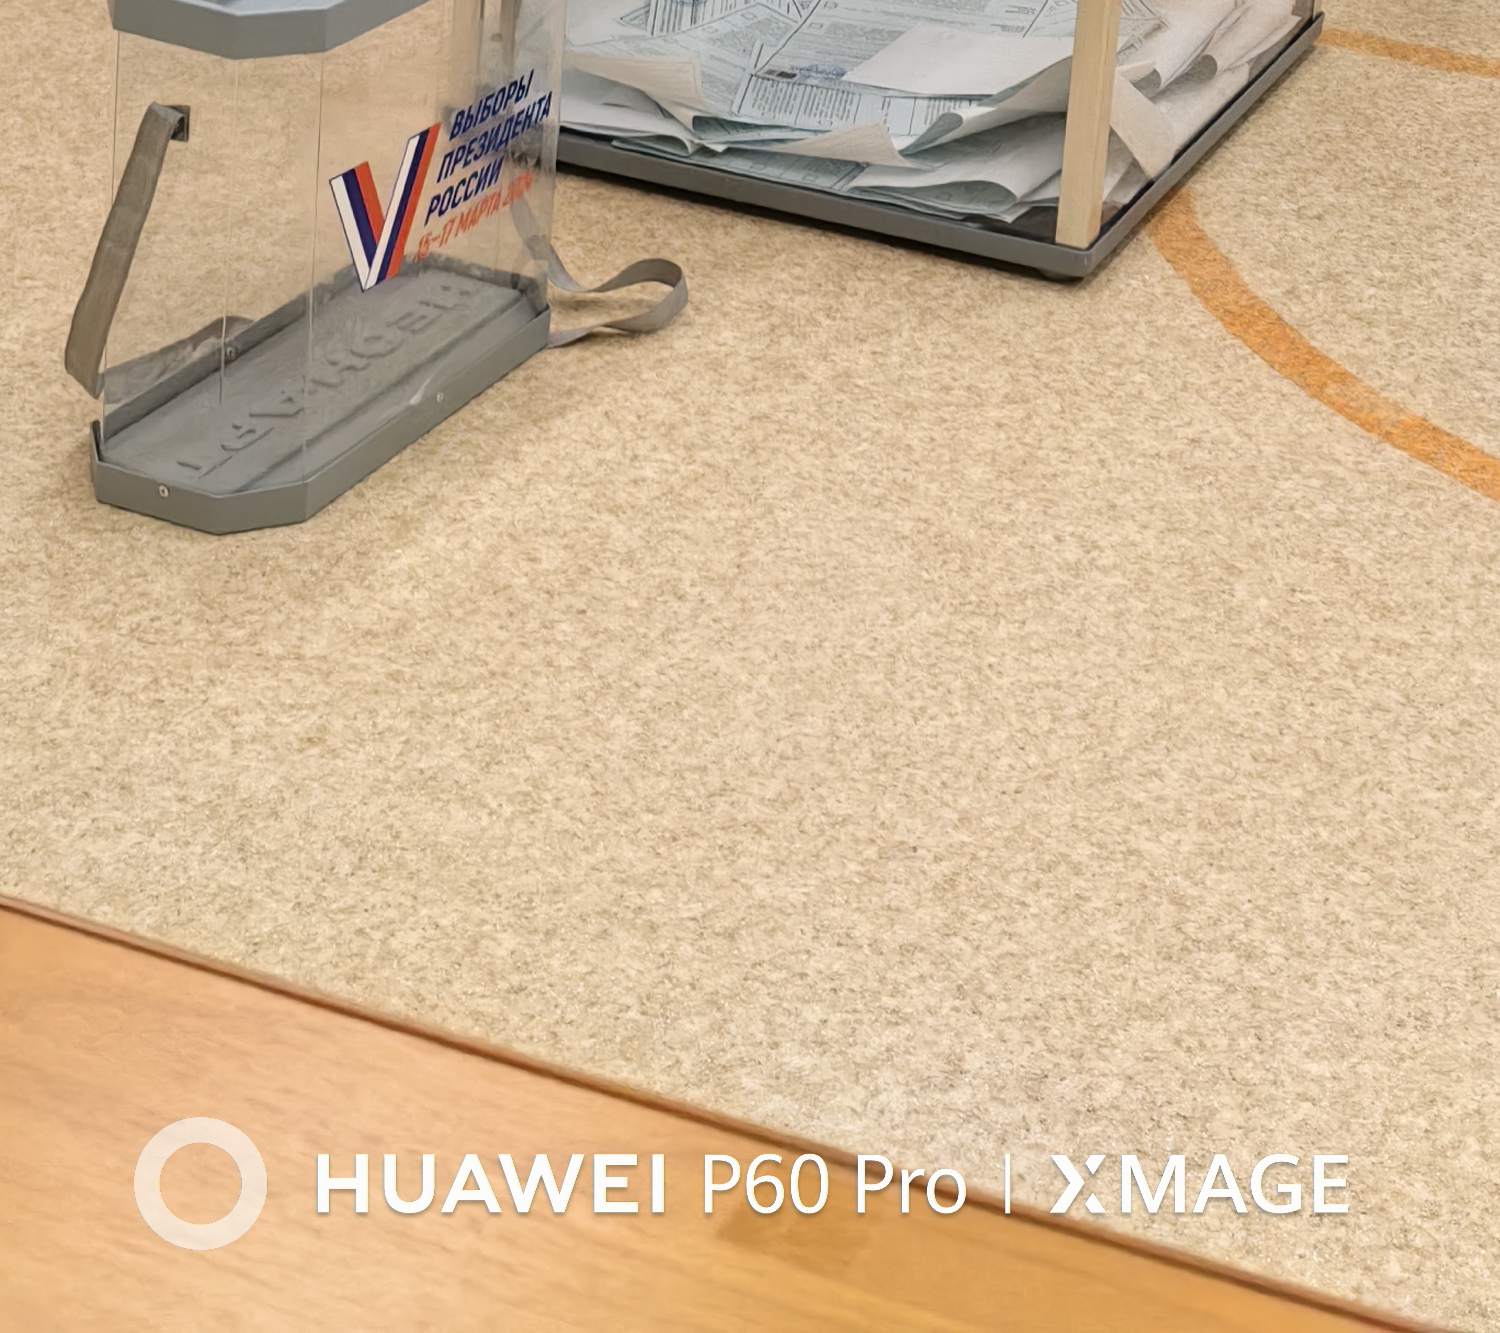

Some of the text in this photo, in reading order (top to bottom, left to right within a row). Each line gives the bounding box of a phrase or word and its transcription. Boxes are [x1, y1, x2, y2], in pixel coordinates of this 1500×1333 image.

[436, 90, 553, 184] ПРЕЗИДЕНТА
[449, 68, 535, 142] ВЫБОРЫ
[423, 156, 505, 228] РОССИИ
